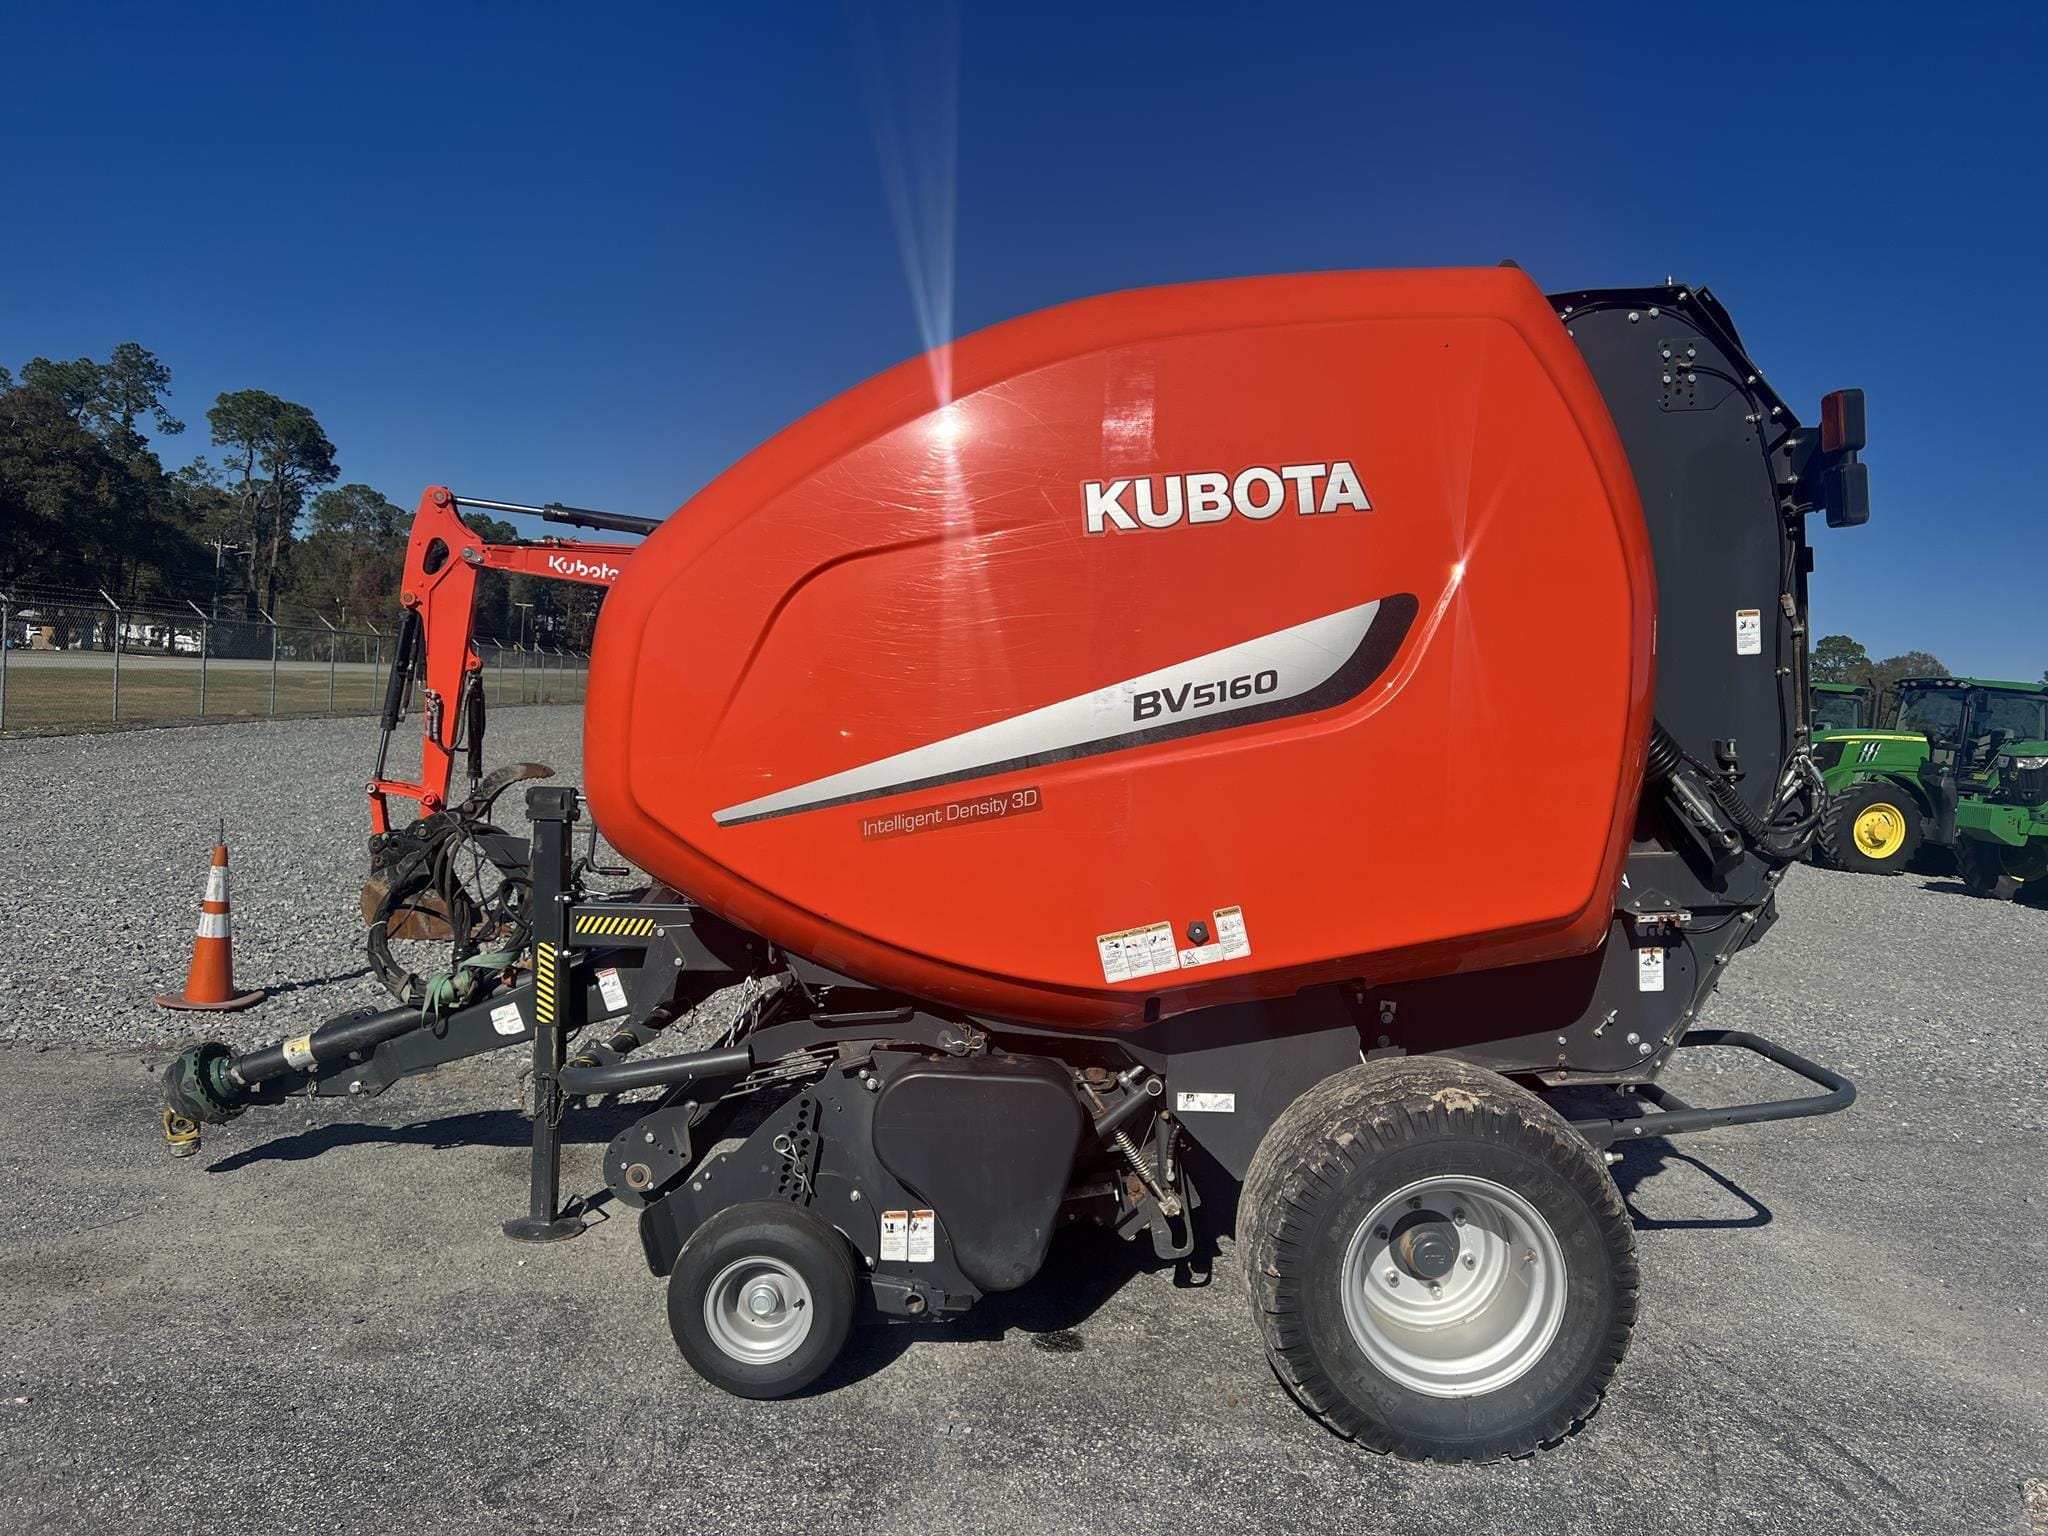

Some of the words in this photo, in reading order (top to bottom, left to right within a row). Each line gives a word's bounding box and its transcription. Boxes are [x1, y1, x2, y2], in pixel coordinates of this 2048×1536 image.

[1084, 461, 1372, 533] KUBOTA
[1133, 669, 1278, 722] BV5160
[863, 809, 943, 836] Intelligent
[946, 797, 1008, 822] Density
[1011, 789, 1037, 809] 3D
